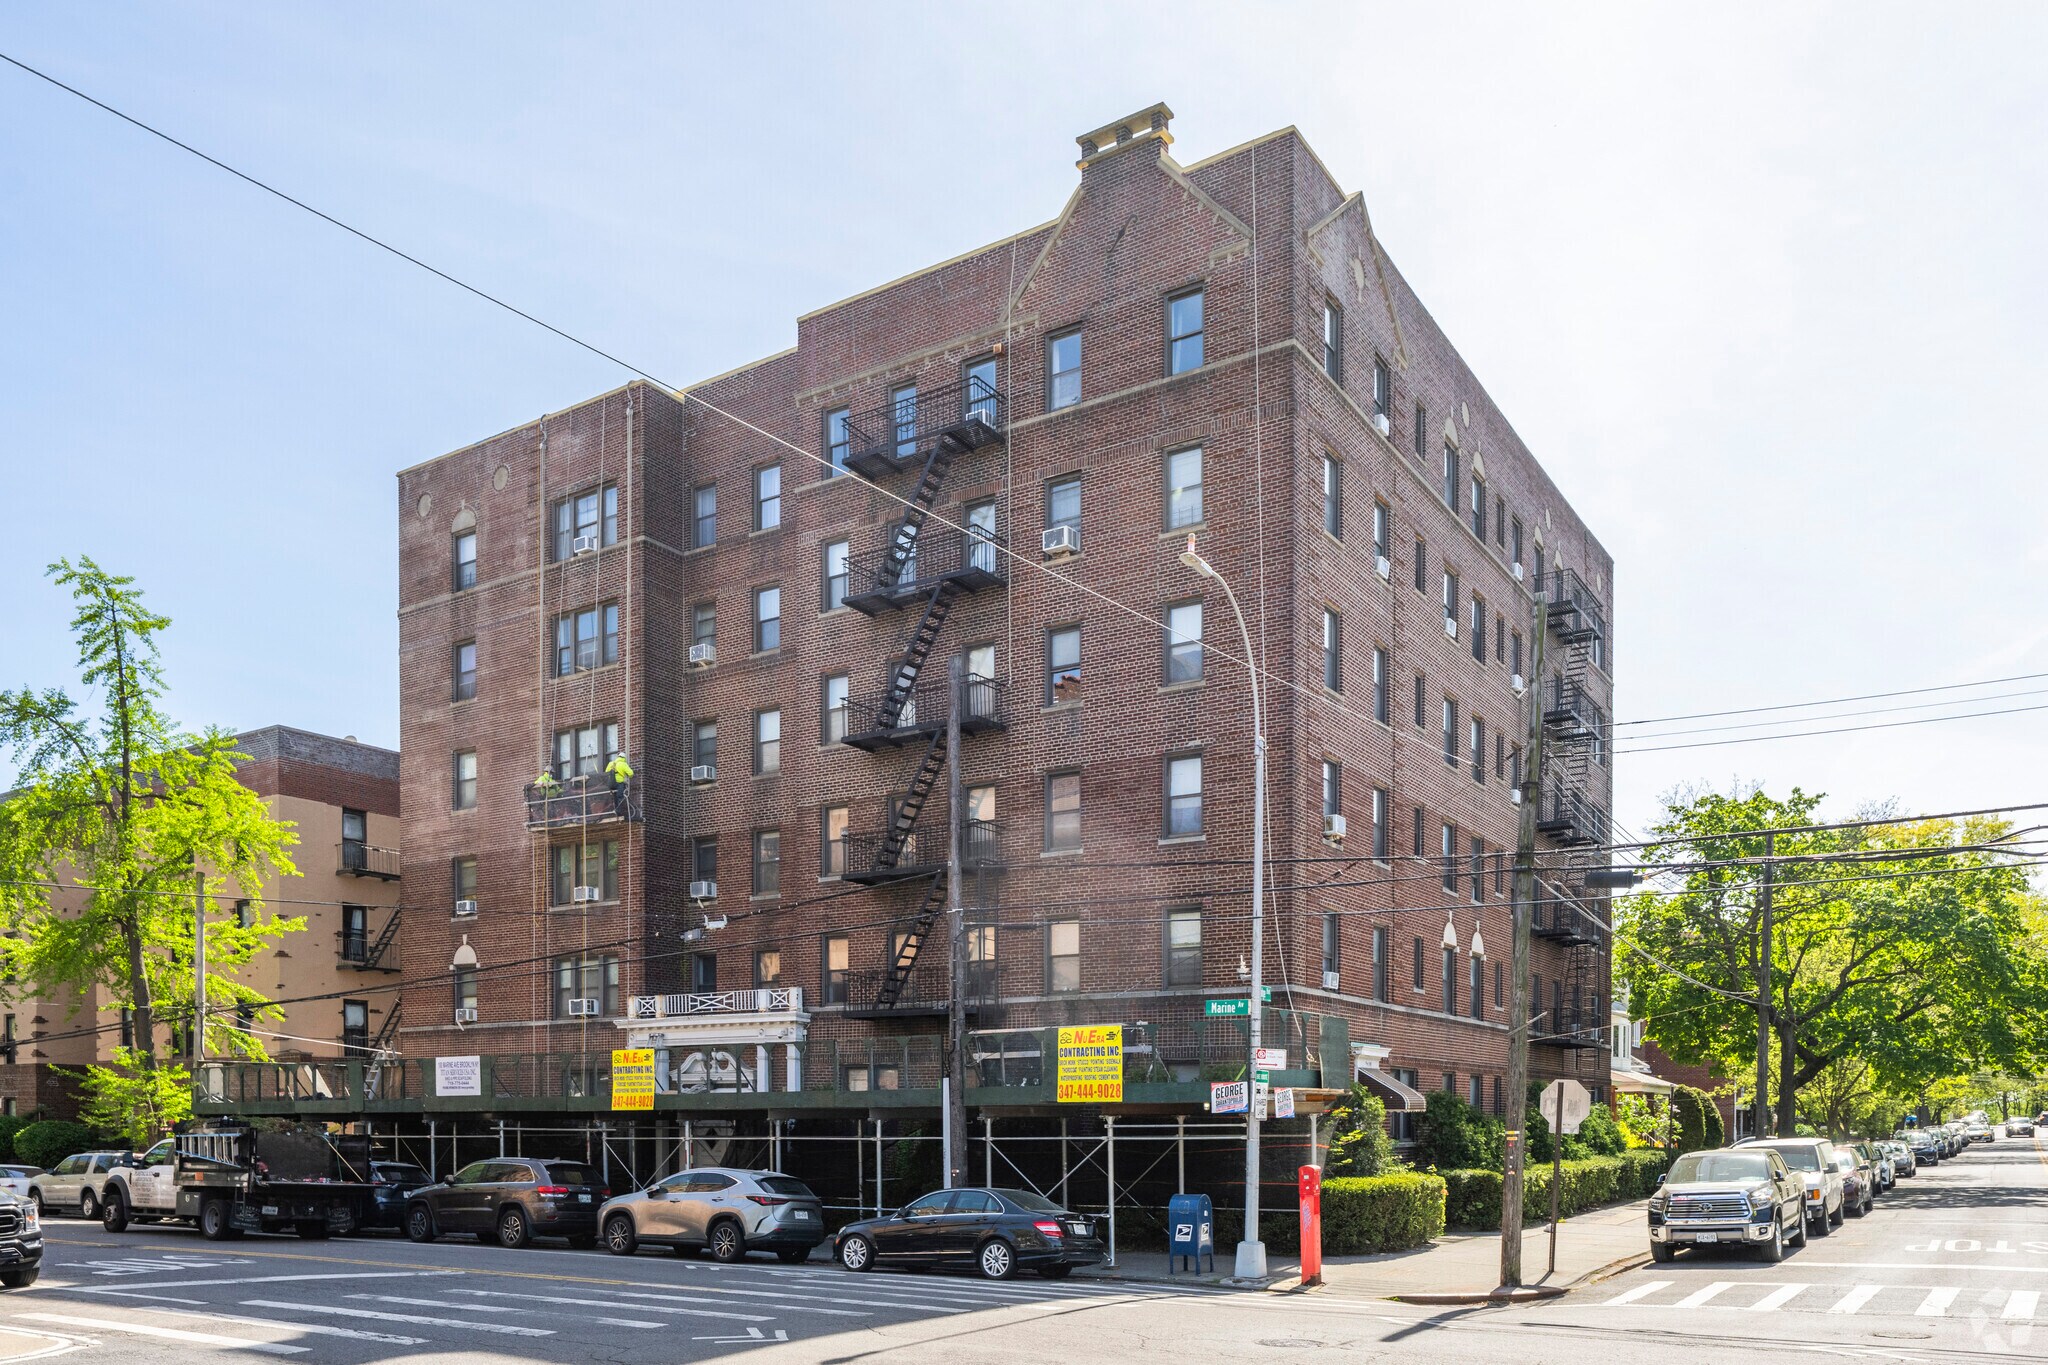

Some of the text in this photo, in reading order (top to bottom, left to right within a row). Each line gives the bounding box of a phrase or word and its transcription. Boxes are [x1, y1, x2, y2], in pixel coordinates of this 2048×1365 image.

[1211, 1002, 1236, 1013] Marine
[1060, 1046, 1121, 1058] CONTRACTING INC.
[614, 1066, 644, 1074] CONTRACTING
[1059, 1084, 1121, 1099] 347-444-9028
[1216, 1084, 1244, 1100] GEORGE
[1277, 1090, 1291, 1104] GEORGE
[613, 1096, 653, 1108] 347-444-9028
